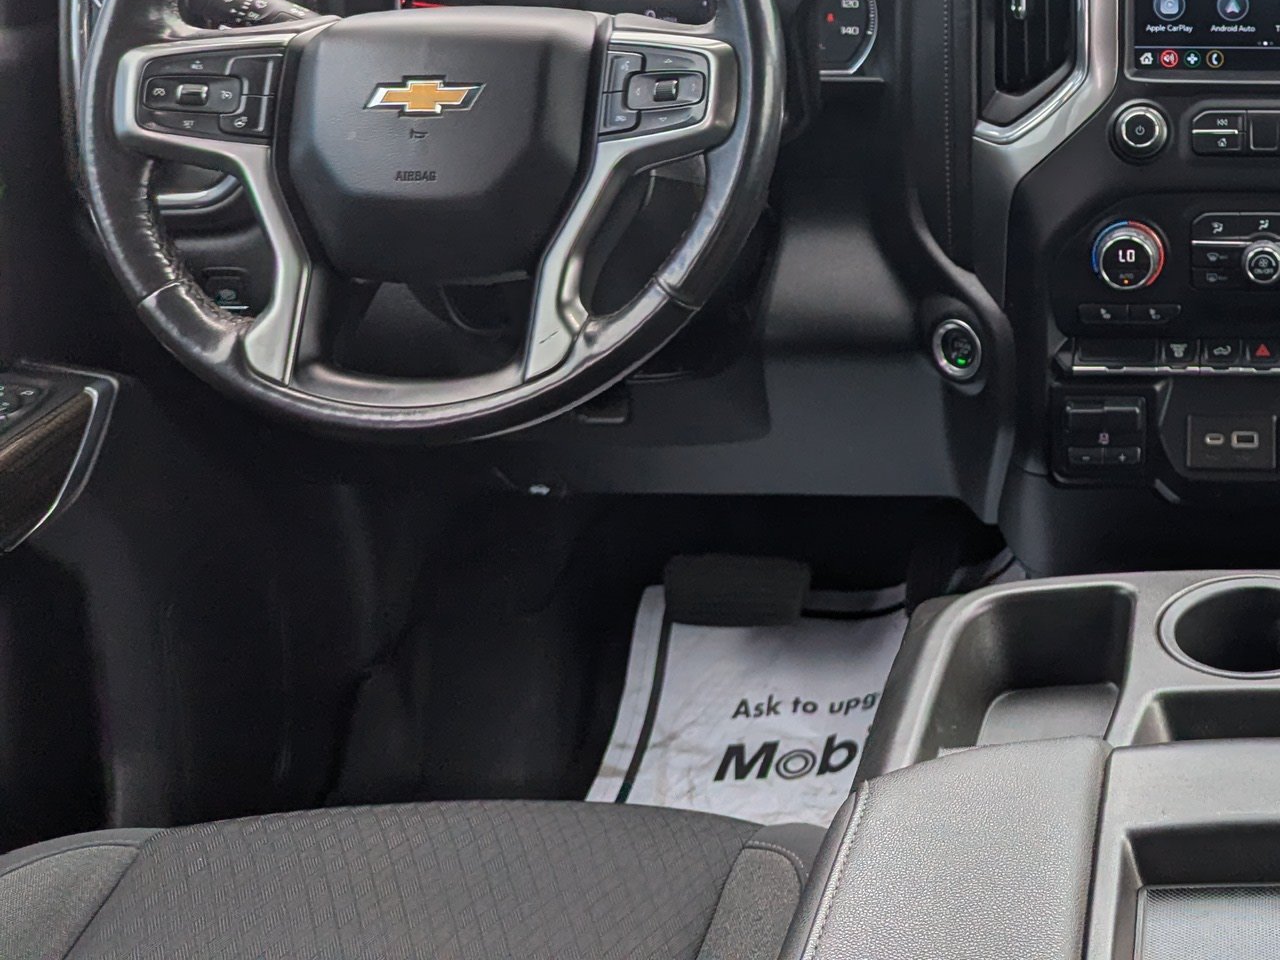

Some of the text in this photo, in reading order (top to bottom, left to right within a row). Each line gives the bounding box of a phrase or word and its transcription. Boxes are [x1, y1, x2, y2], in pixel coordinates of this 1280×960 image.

[842, 0, 860, 8] 120
[841, 26, 860, 35] 140
[1146, 24, 1194, 34] Apple CarPlay
[1210, 24, 1256, 32] Android Auto
[394, 170, 437, 182] AIRBAG
[1118, 249, 1136, 262] LO
[732, 694, 781, 720] Ask
[792, 697, 819, 715] to
[713, 733, 859, 782] Mob
